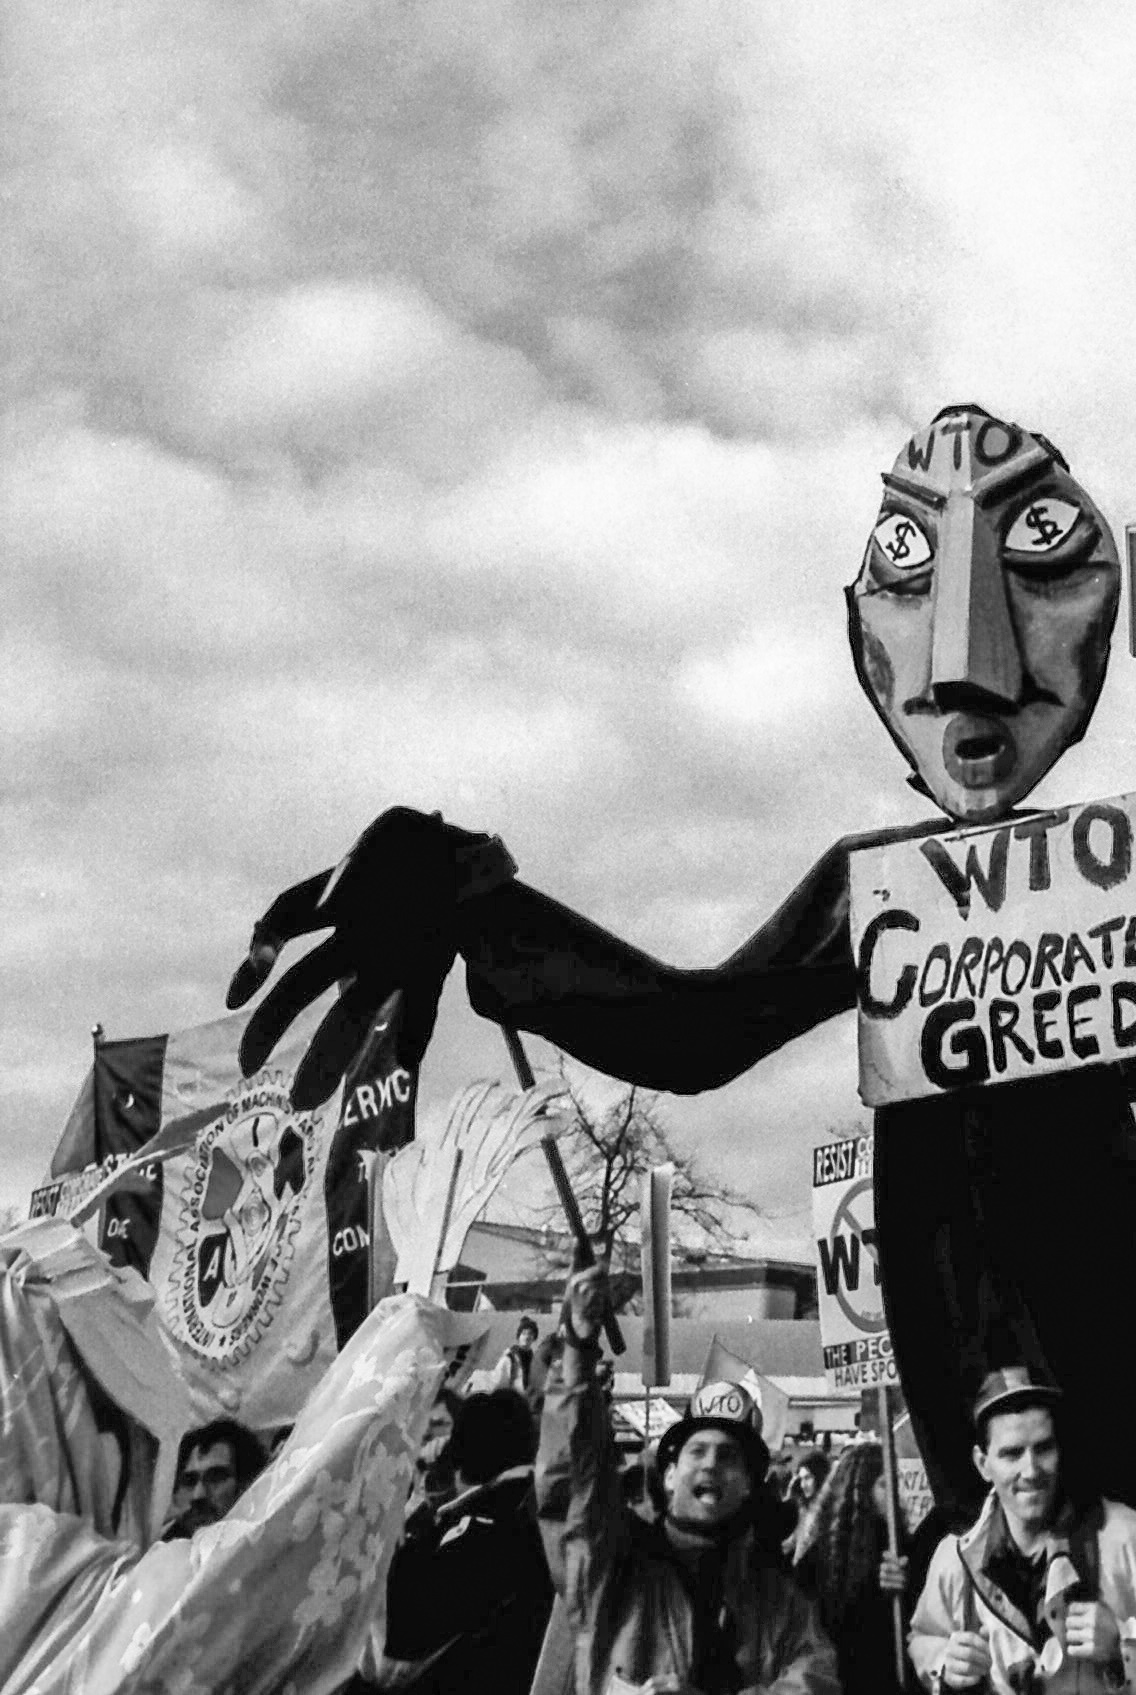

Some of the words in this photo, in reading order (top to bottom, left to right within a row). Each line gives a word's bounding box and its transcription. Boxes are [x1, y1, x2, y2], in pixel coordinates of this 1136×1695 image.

[908, 418, 1023, 472] WTO
[919, 803, 1134, 921] WTO
[190, 1120, 225, 1232] ASSOCIATION
[226, 1103, 240, 1124] OF
[816, 1140, 854, 1184] RESIST
[817, 1228, 882, 1295] WT
[825, 1344, 848, 1367] THE
[834, 1363, 867, 1387] HAVE
[698, 1391, 740, 1416] WTO
